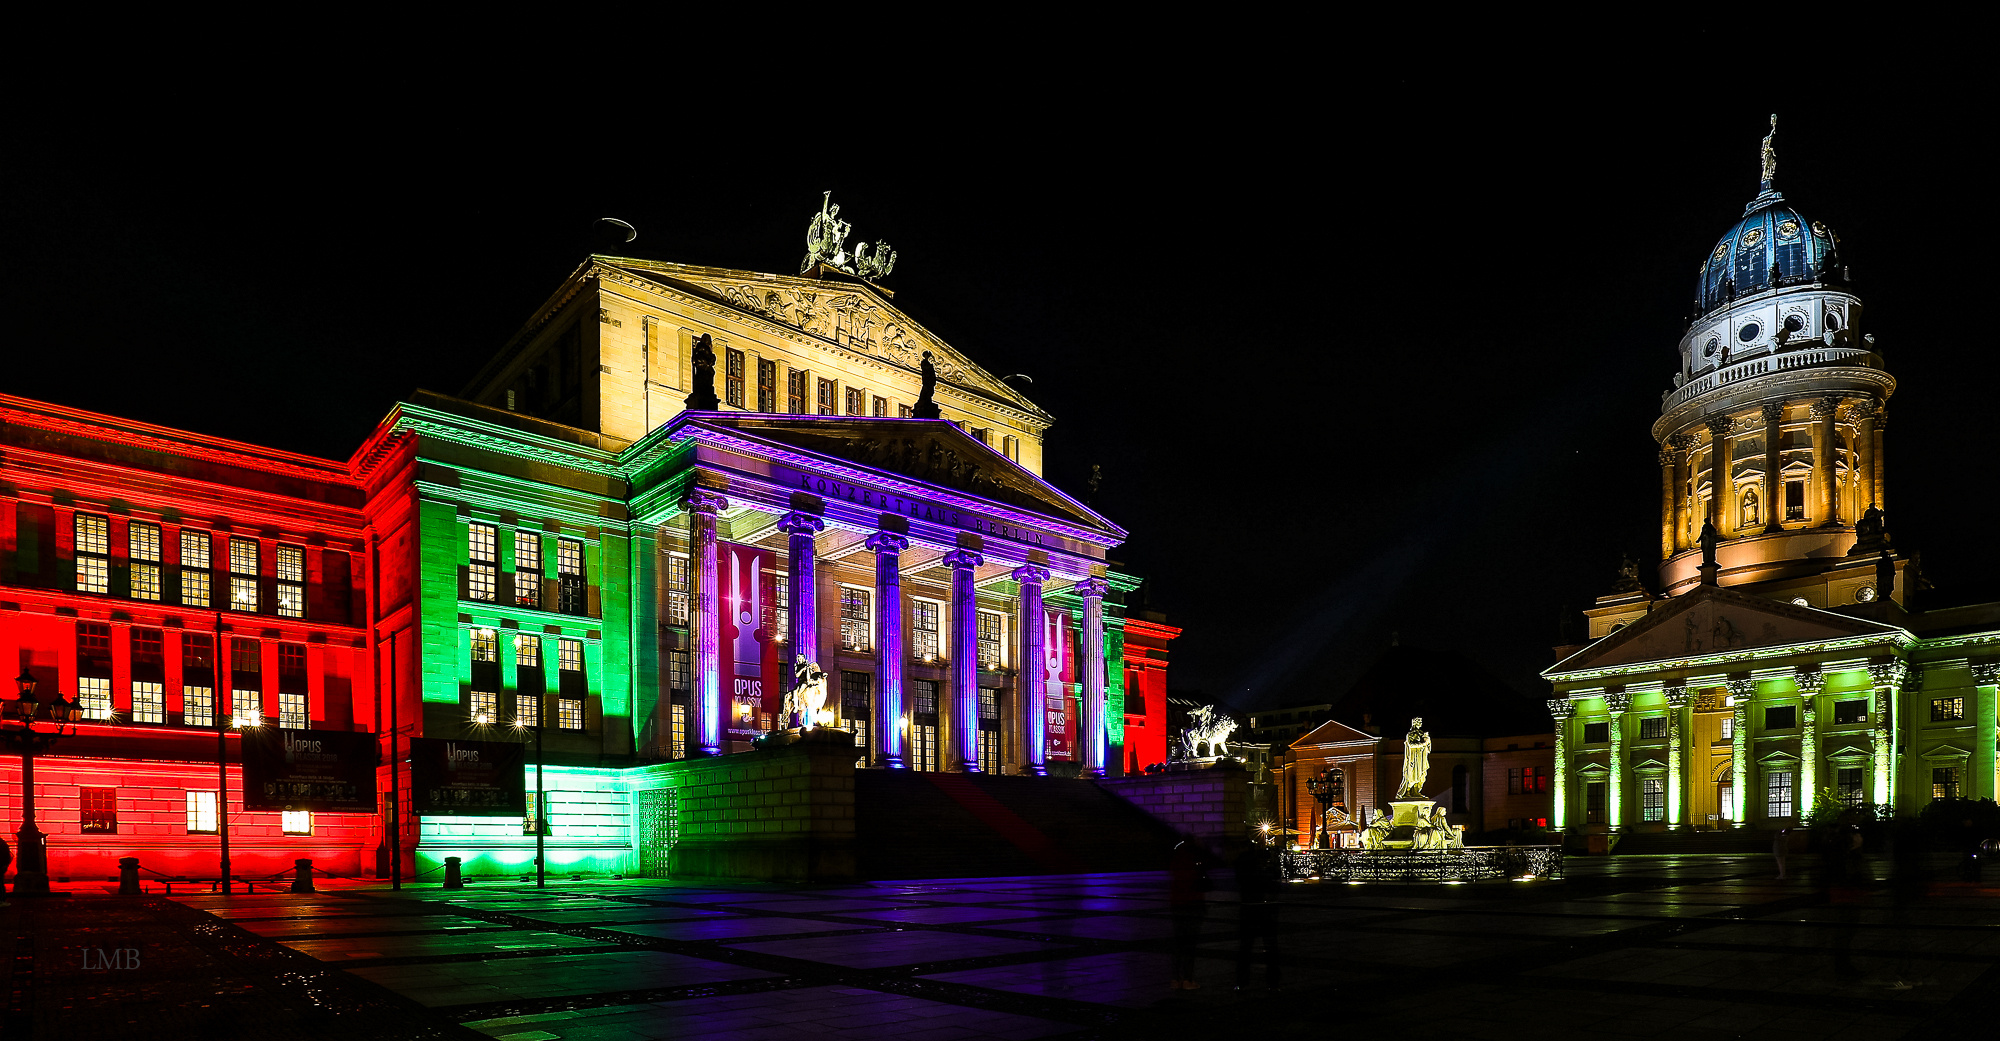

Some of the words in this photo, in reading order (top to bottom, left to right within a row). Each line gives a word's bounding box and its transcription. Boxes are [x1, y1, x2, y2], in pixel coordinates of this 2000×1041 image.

[801, 475, 959, 524] KONZERTHAUS
[976, 519, 1043, 545] BERLIN
[734, 678, 762, 697] OPUS
[1048, 711, 1065, 725] OPUS
[295, 739, 322, 753] OPUS
[295, 753, 321, 762] KLASSIK
[321, 753, 338, 763] 2018
[456, 749, 479, 762] OPUS
